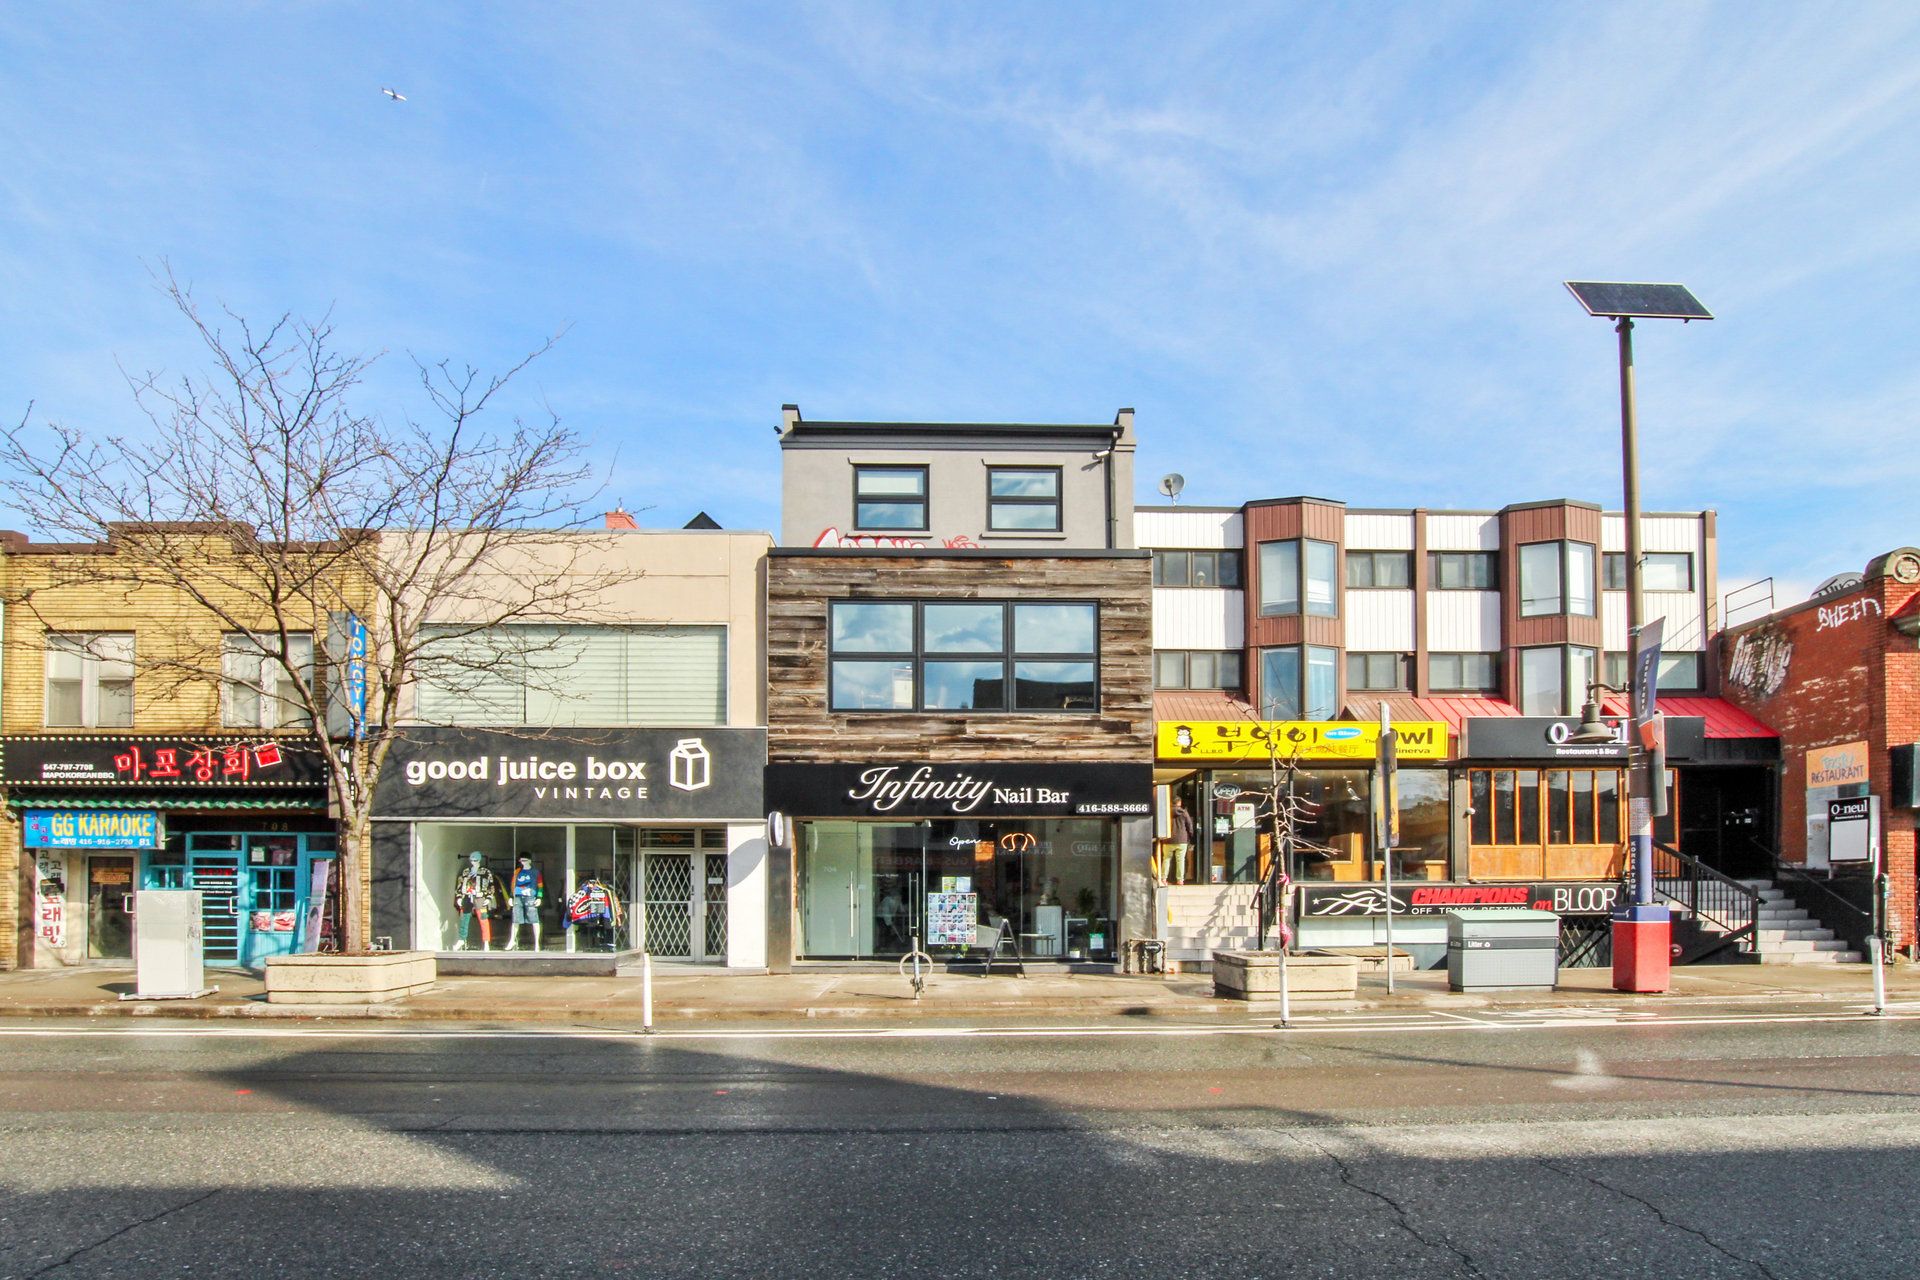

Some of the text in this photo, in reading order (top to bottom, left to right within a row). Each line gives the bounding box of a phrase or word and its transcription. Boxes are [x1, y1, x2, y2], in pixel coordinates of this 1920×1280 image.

[113, 745, 252, 781] 마포상회
[406, 756, 646, 786] good juice box
[535, 787, 648, 799] VINTAGE
[849, 766, 1069, 812] Infinity Nail Bar
[1078, 803, 1148, 813] 416-588-8666
[1831, 799, 1868, 815] O-neul
[51, 812, 75, 836] GG
[78, 812, 152, 836] KARAOKE
[949, 836, 981, 849] Open
[1411, 887, 1529, 904] CHAMPIONS
[1532, 888, 1617, 912] on BLOOR
[1411, 907, 1431, 915] OFF
